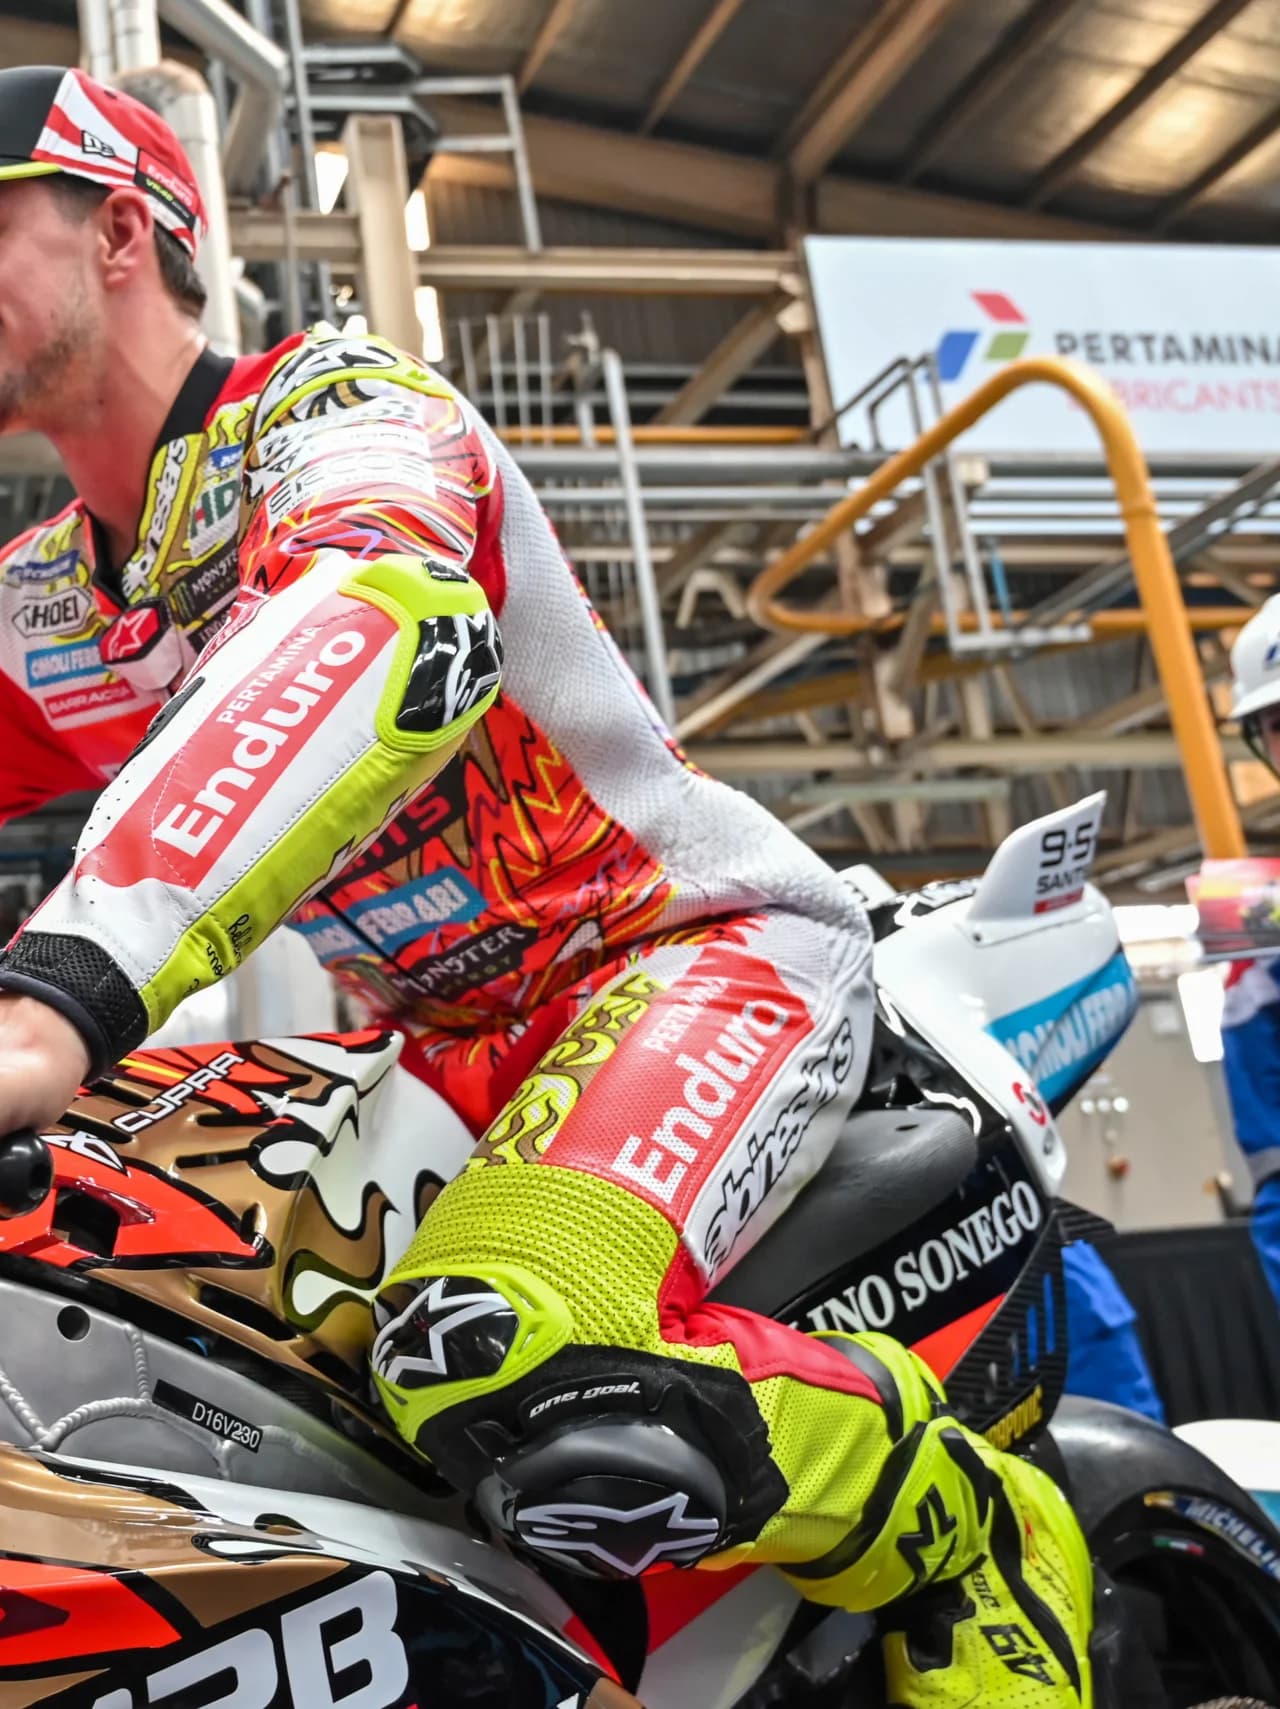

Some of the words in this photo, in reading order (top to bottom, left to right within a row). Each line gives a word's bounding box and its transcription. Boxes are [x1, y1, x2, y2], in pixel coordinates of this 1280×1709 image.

[22, 594, 80, 631] SHOEI
[217, 626, 322, 725] PERTAMINA
[153, 630, 366, 858] Enduro
[113, 1051, 246, 1134] CUPRA
[612, 1000, 789, 1204] Enduro
[790, 1273, 895, 1334] INO
[894, 1180, 1040, 1311] SONEGO
[191, 1402, 261, 1449] D16V230
[529, 1391, 579, 1418] one
